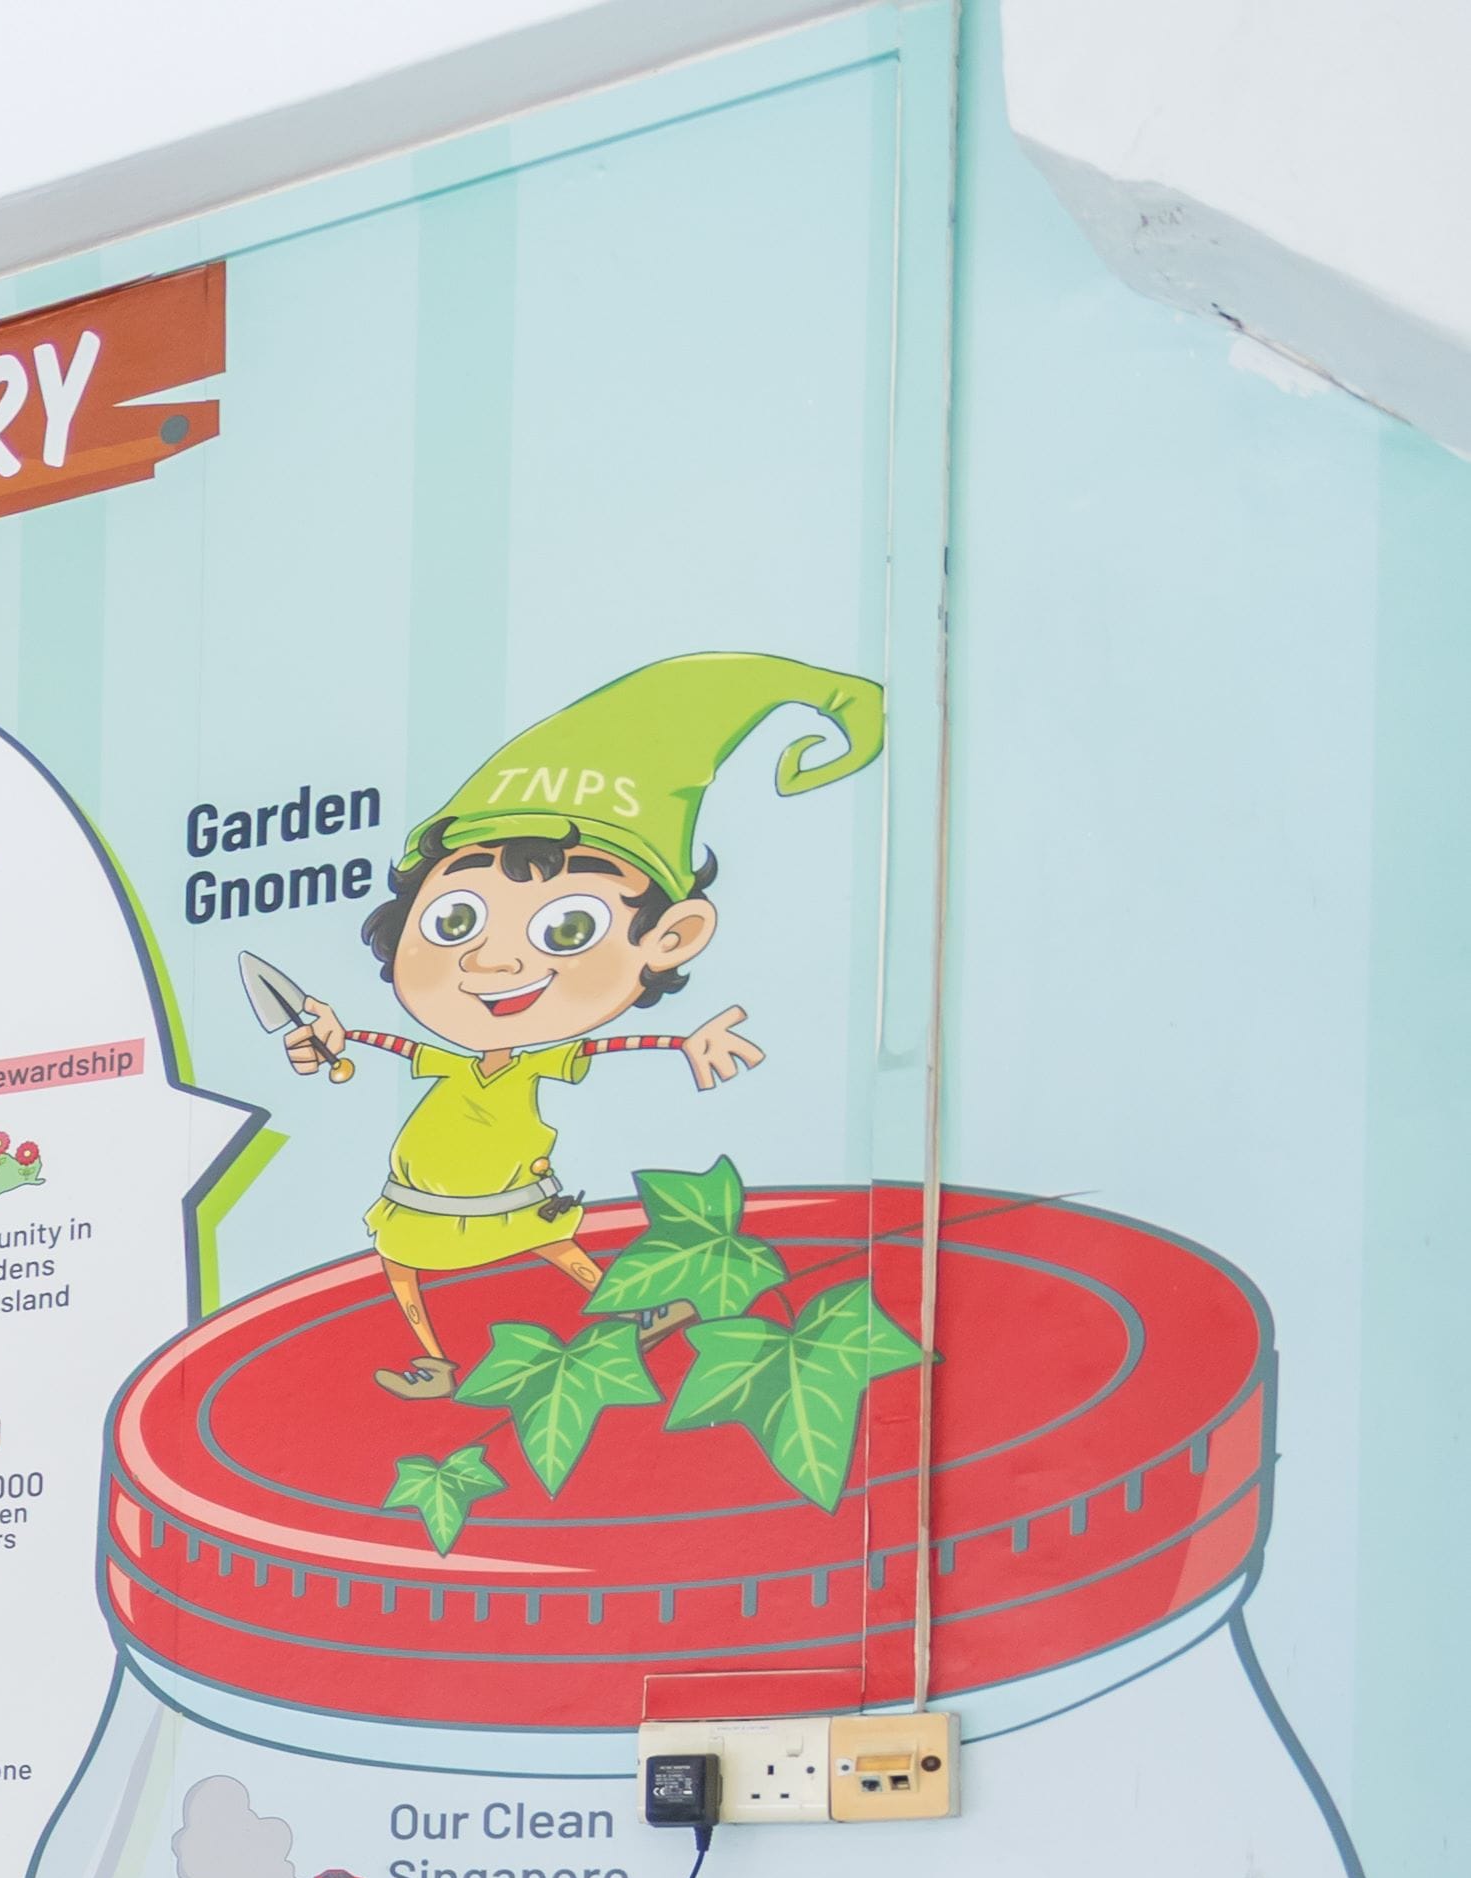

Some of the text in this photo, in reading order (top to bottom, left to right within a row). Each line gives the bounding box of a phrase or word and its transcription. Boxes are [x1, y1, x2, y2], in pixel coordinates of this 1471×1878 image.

[186, 785, 382, 859] Garden
[486, 766, 641, 818] TNPS
[185, 856, 372, 925] Gnome
[391, 1803, 613, 1840] Our Clean
